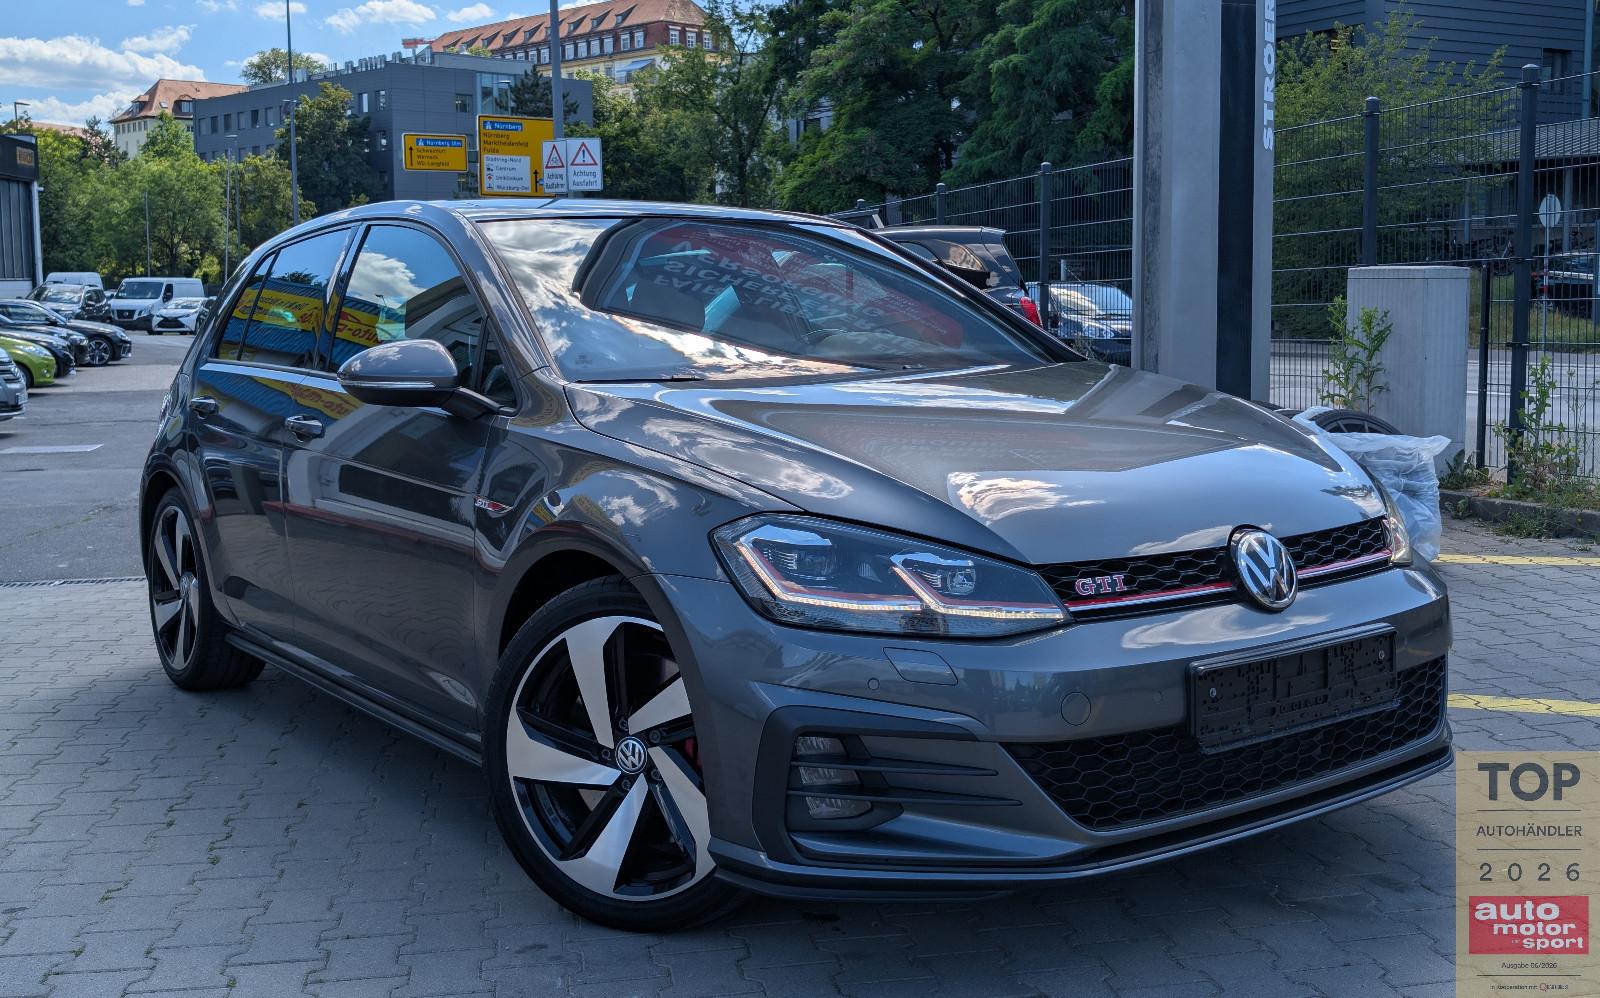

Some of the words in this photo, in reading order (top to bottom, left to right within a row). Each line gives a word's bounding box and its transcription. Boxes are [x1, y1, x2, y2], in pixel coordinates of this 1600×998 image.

[494, 122, 522, 131] Nürnberg
[483, 132, 510, 140] Nürnberg
[547, 172, 564, 180] Achtung
[573, 169, 597, 178] Achtung
[572, 179, 598, 187] Ausfahrt
[1075, 574, 1128, 596] GTI
